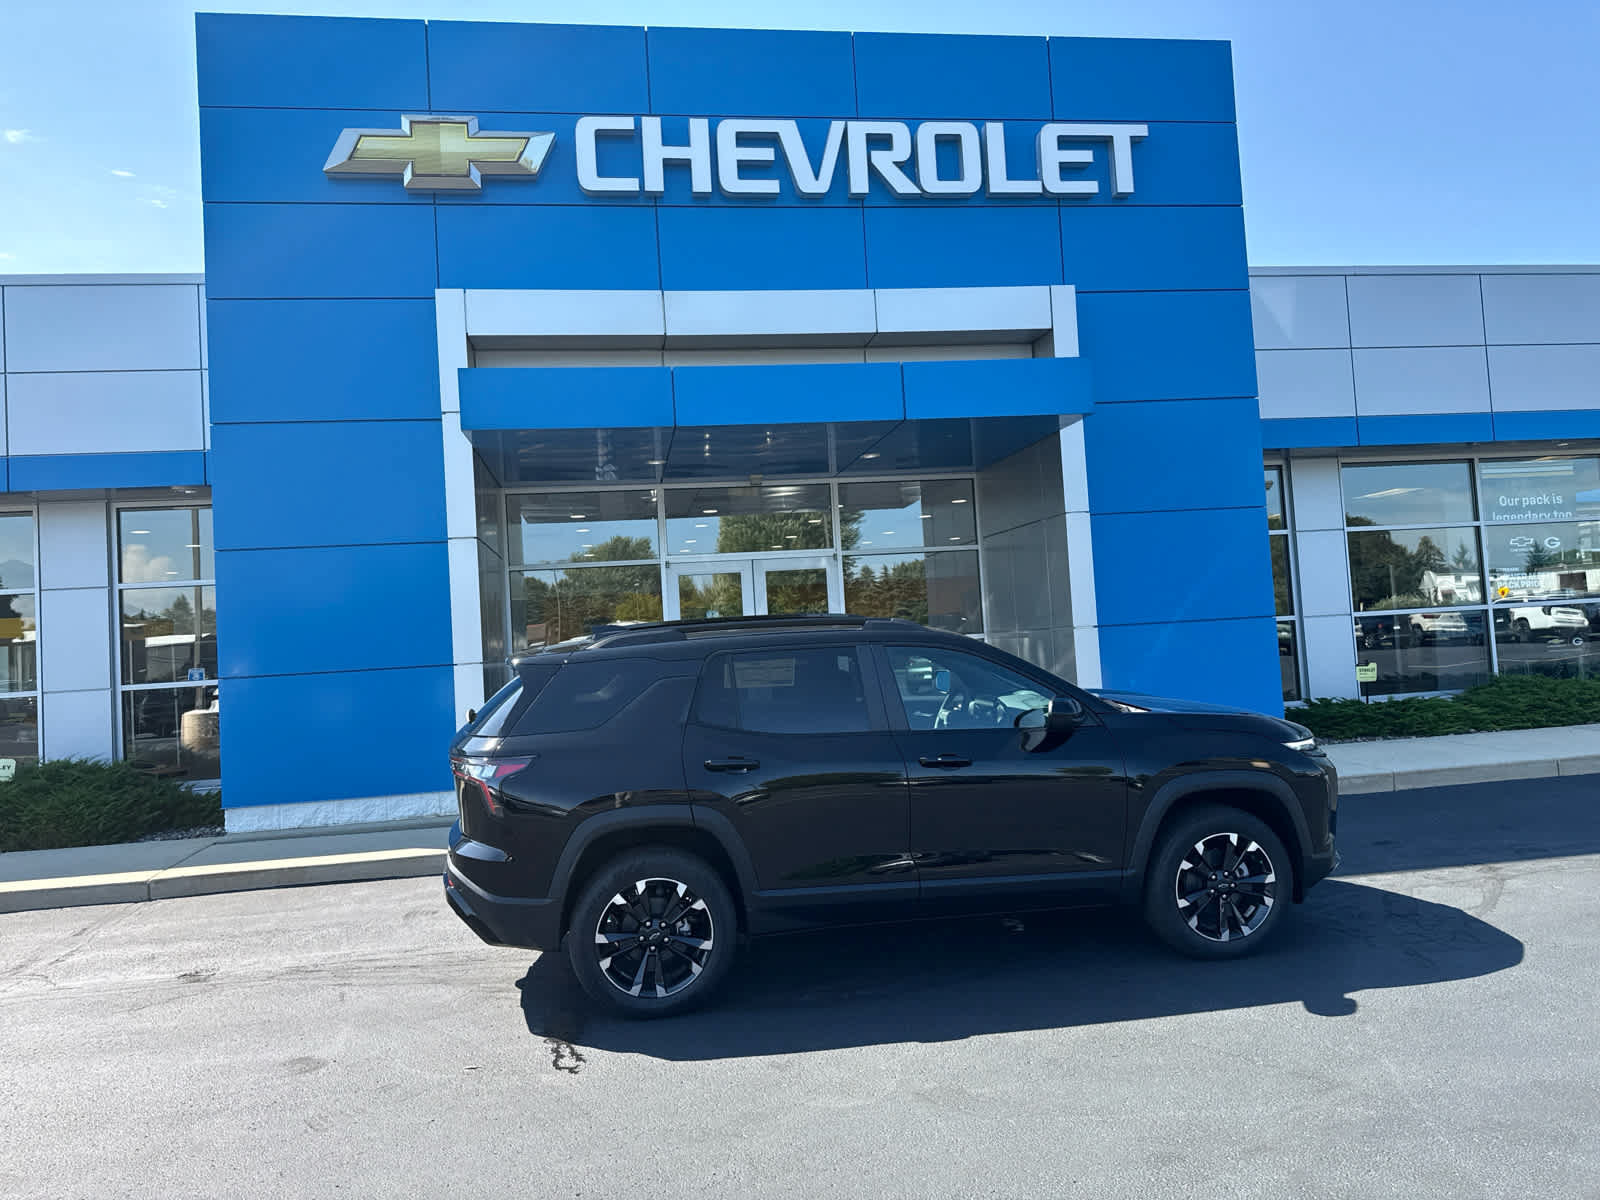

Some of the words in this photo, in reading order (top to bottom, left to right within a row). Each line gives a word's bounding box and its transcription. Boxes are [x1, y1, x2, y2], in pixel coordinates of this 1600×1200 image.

[575, 116, 1149, 197] CHEVROLET
[1499, 496, 1519, 506] Our
[1522, 494, 1550, 508] pack
[1552, 493, 1563, 504] is
